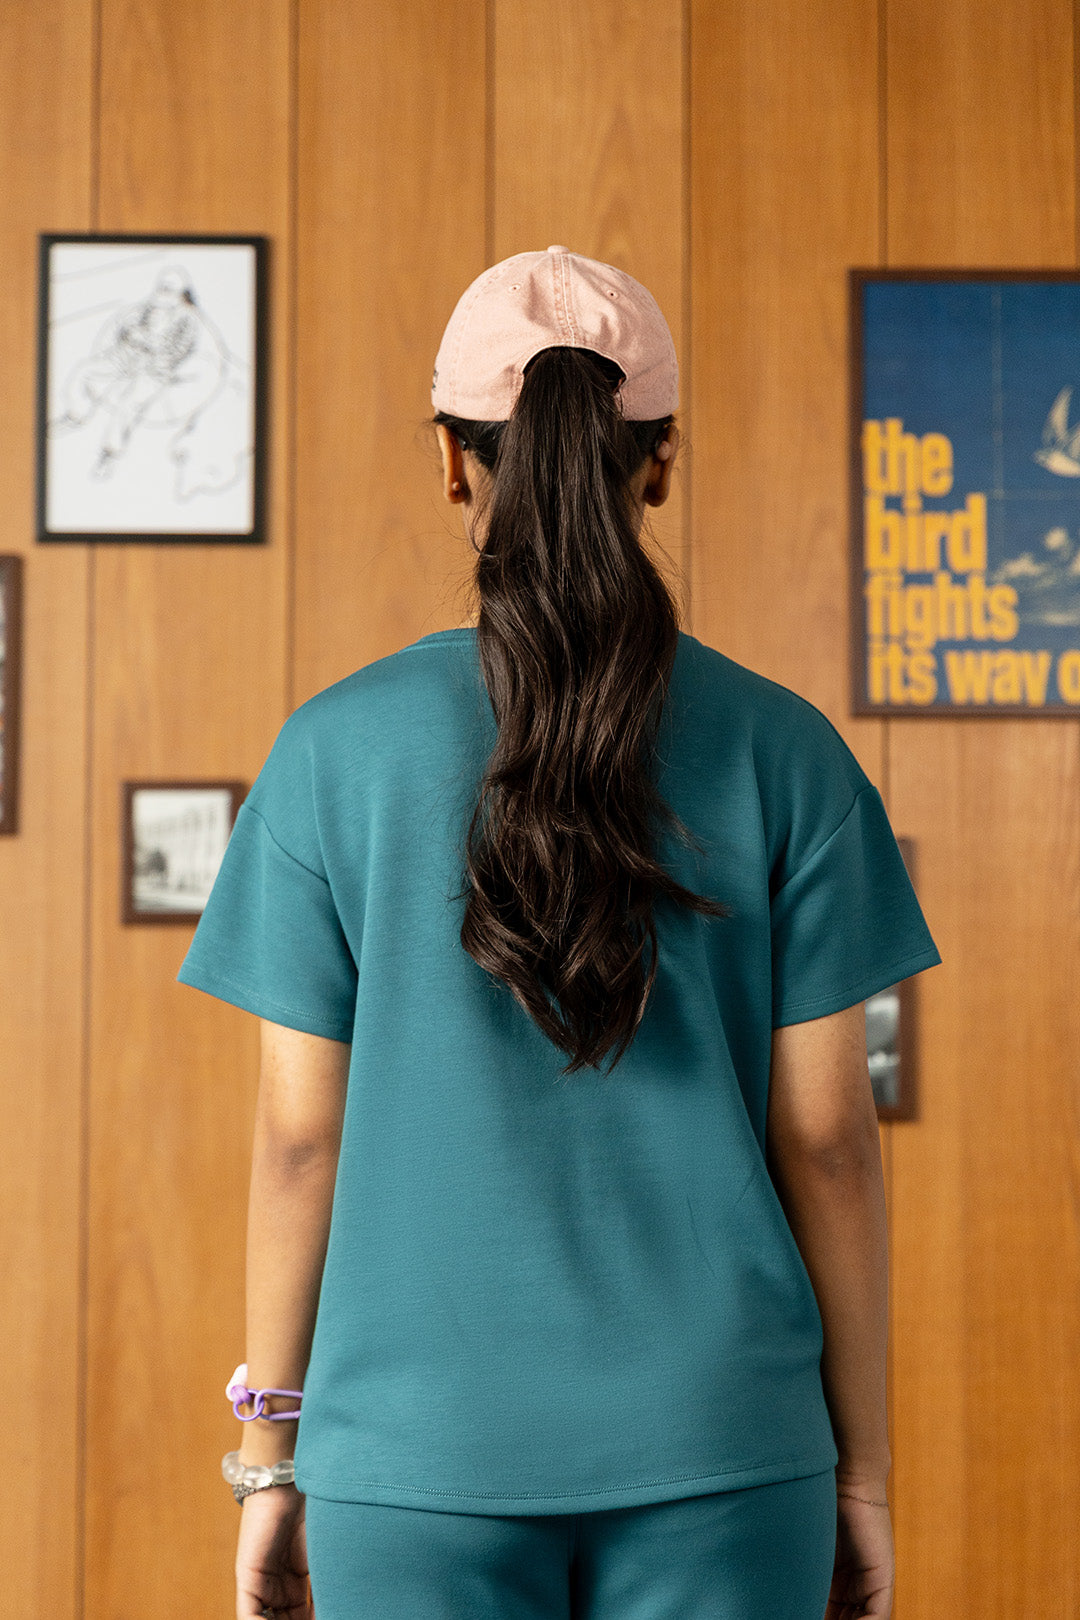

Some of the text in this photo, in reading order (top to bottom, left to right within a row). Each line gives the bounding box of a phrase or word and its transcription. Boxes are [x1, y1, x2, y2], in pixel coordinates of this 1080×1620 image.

[862, 418, 953, 495] the
[865, 493, 987, 572] bird
[865, 572, 1019, 650] fights
[868, 643, 937, 705] its
[946, 649, 1051, 707] way
